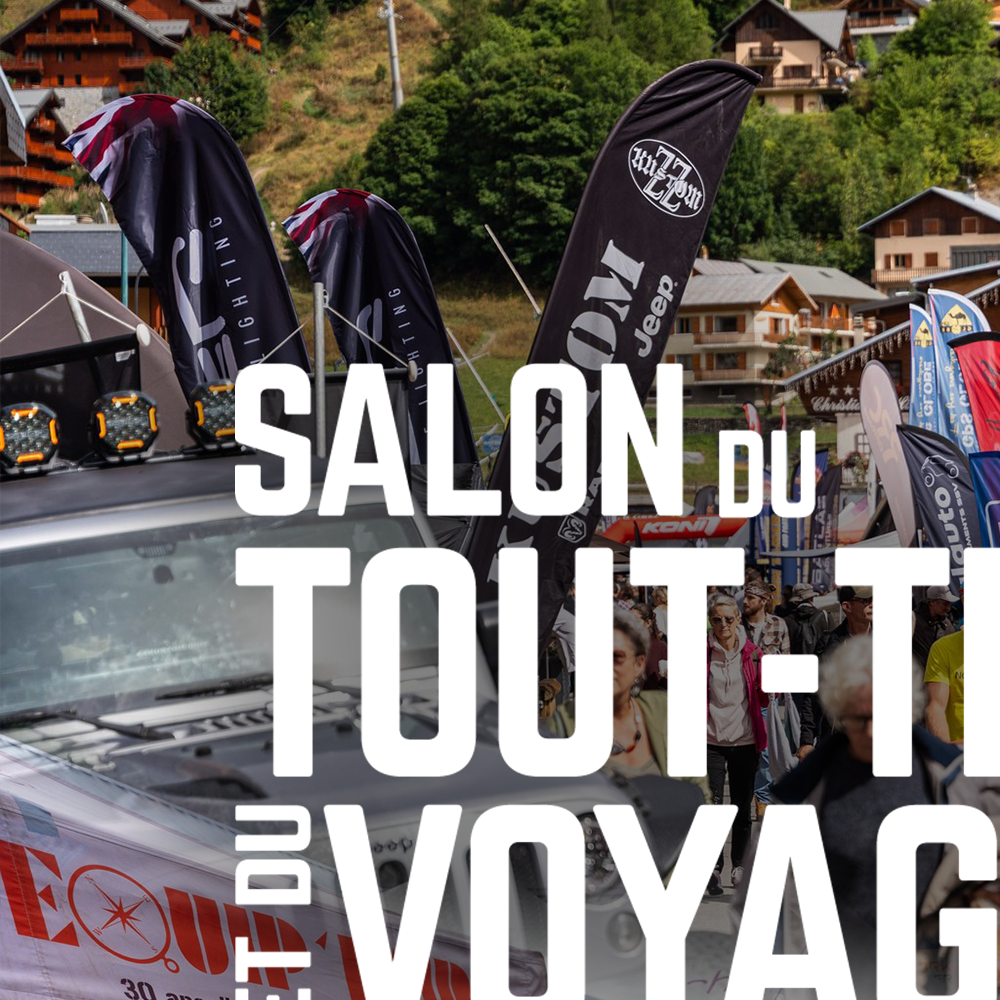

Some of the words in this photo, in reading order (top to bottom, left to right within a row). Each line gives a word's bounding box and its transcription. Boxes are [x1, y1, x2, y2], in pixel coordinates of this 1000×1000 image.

[634, 273, 678, 358] Jeep
[811, 396, 860, 411] Christia
[935, 487, 965, 585] lauto
